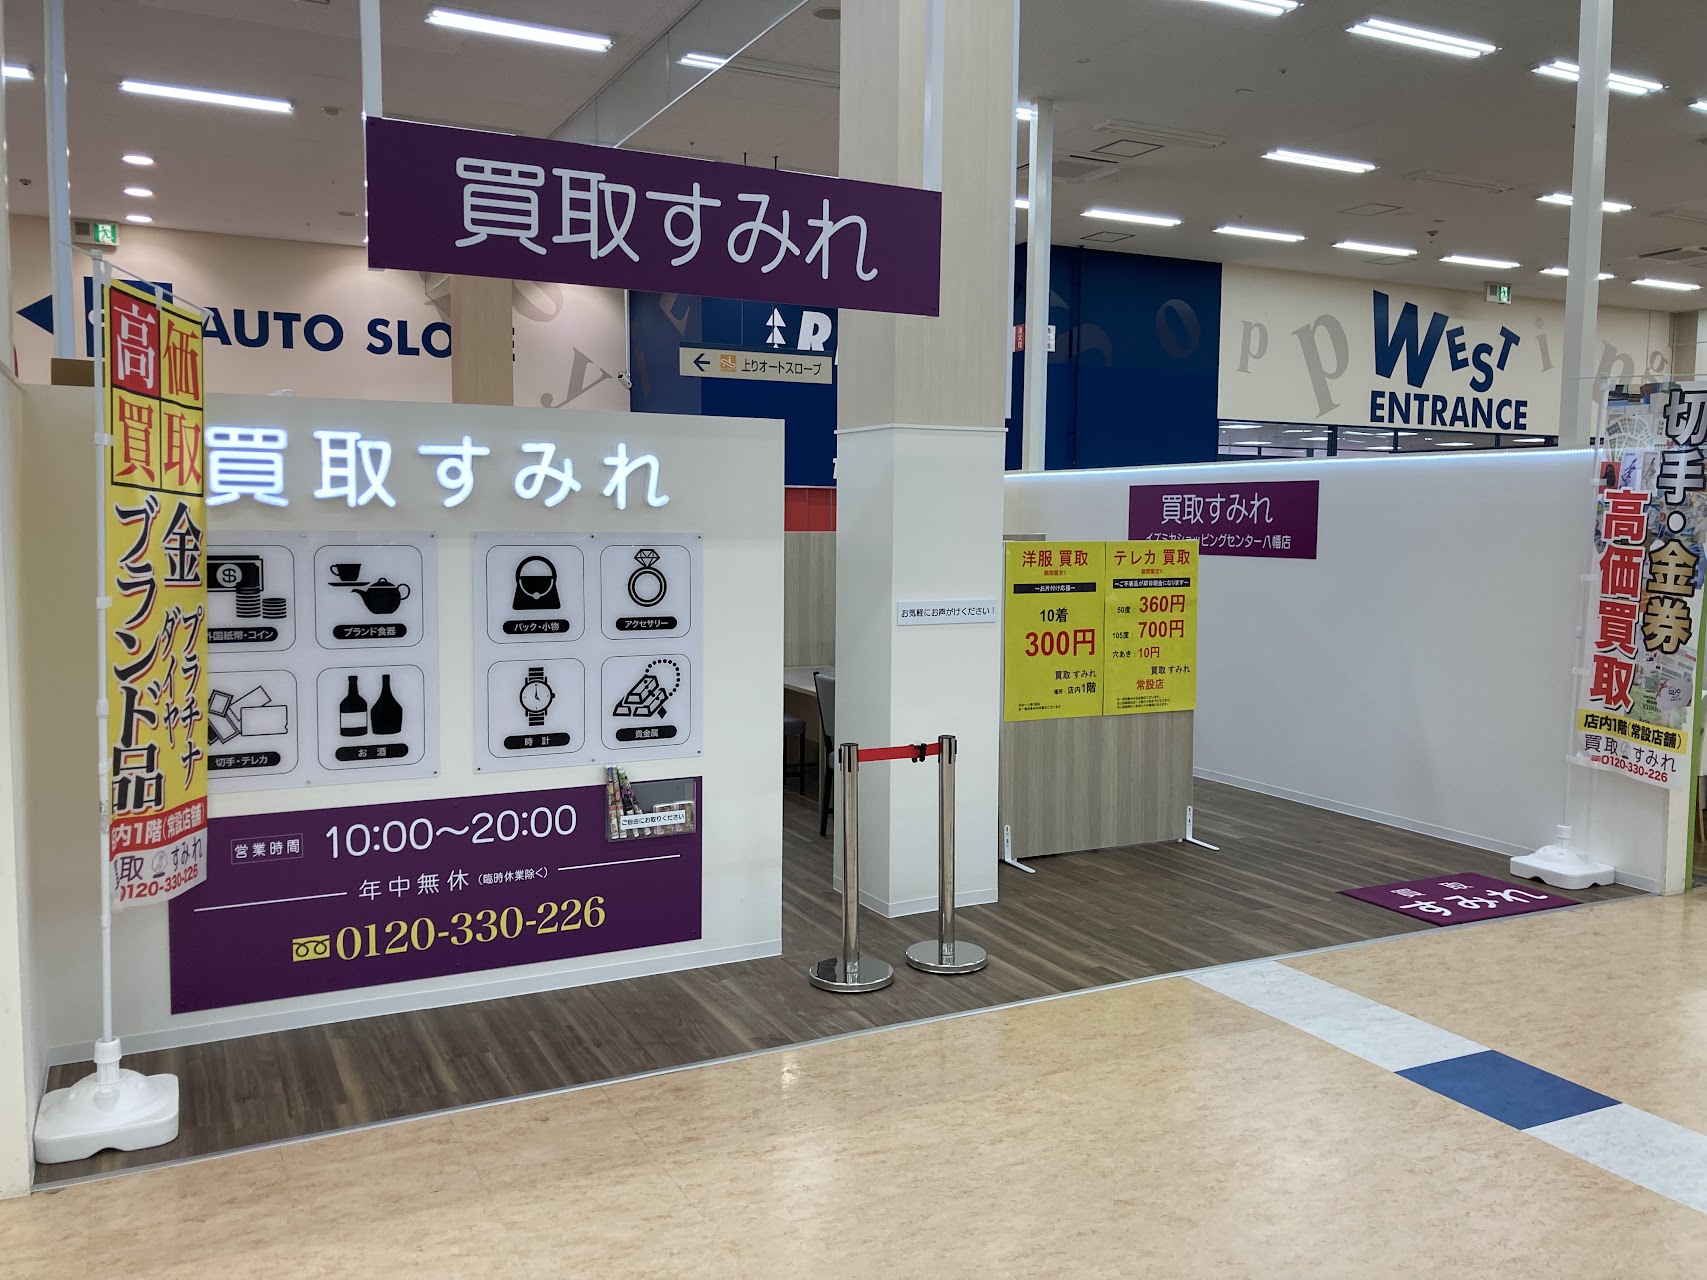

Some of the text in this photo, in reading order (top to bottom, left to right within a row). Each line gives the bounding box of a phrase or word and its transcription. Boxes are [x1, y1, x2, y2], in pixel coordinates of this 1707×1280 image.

[455, 156, 879, 282] 買取すみれ
[202, 305, 344, 352] AUTO
[1372, 289, 1521, 393] WEST
[741, 358, 822, 375] 上りオートスロープ
[1370, 390, 1528, 431] ENTRANCE
[204, 425, 671, 510] 買取すみれ
[1161, 492, 1273, 524] 買取すみれ
[1022, 550, 1088, 567] 洋服 買取
[1114, 549, 1190, 565] テレカ 買取
[1139, 594, 1185, 613] 360円
[1590, 490, 1648, 708] 高価買取
[624, 619, 669, 629] アクセサリー
[1039, 607, 1068, 623] 10着
[1138, 619, 1184, 638] 700円
[343, 626, 396, 637] ブランド食器
[1025, 628, 1095, 657] 300円
[1138, 646, 1160, 658] 10円
[160, 605, 182, 750] ダイヤ
[1055, 669, 1097, 680] 買取 すみれ
[1151, 665, 1190, 675] 買取 すみれ
[181, 605, 204, 790] プラチナ
[1067, 682, 1096, 694] 店内1階
[1136, 679, 1164, 690] 常設店
[635, 728, 659, 739] 貴金属
[1584, 714, 1682, 750] 店内1階(常設店舗)
[215, 755, 268, 767] 切手・テレカ
[1584, 734, 1677, 773] 買取 すみれ
[1601, 755, 1668, 783] 0120-330-226
[171, 836, 203, 872] すみれ
[233, 839, 301, 860] 営業時間
[358, 868, 470, 900] 年中無休
[1399, 888, 1549, 917] すみれ
[336, 895, 606, 960] 0120-330-226
